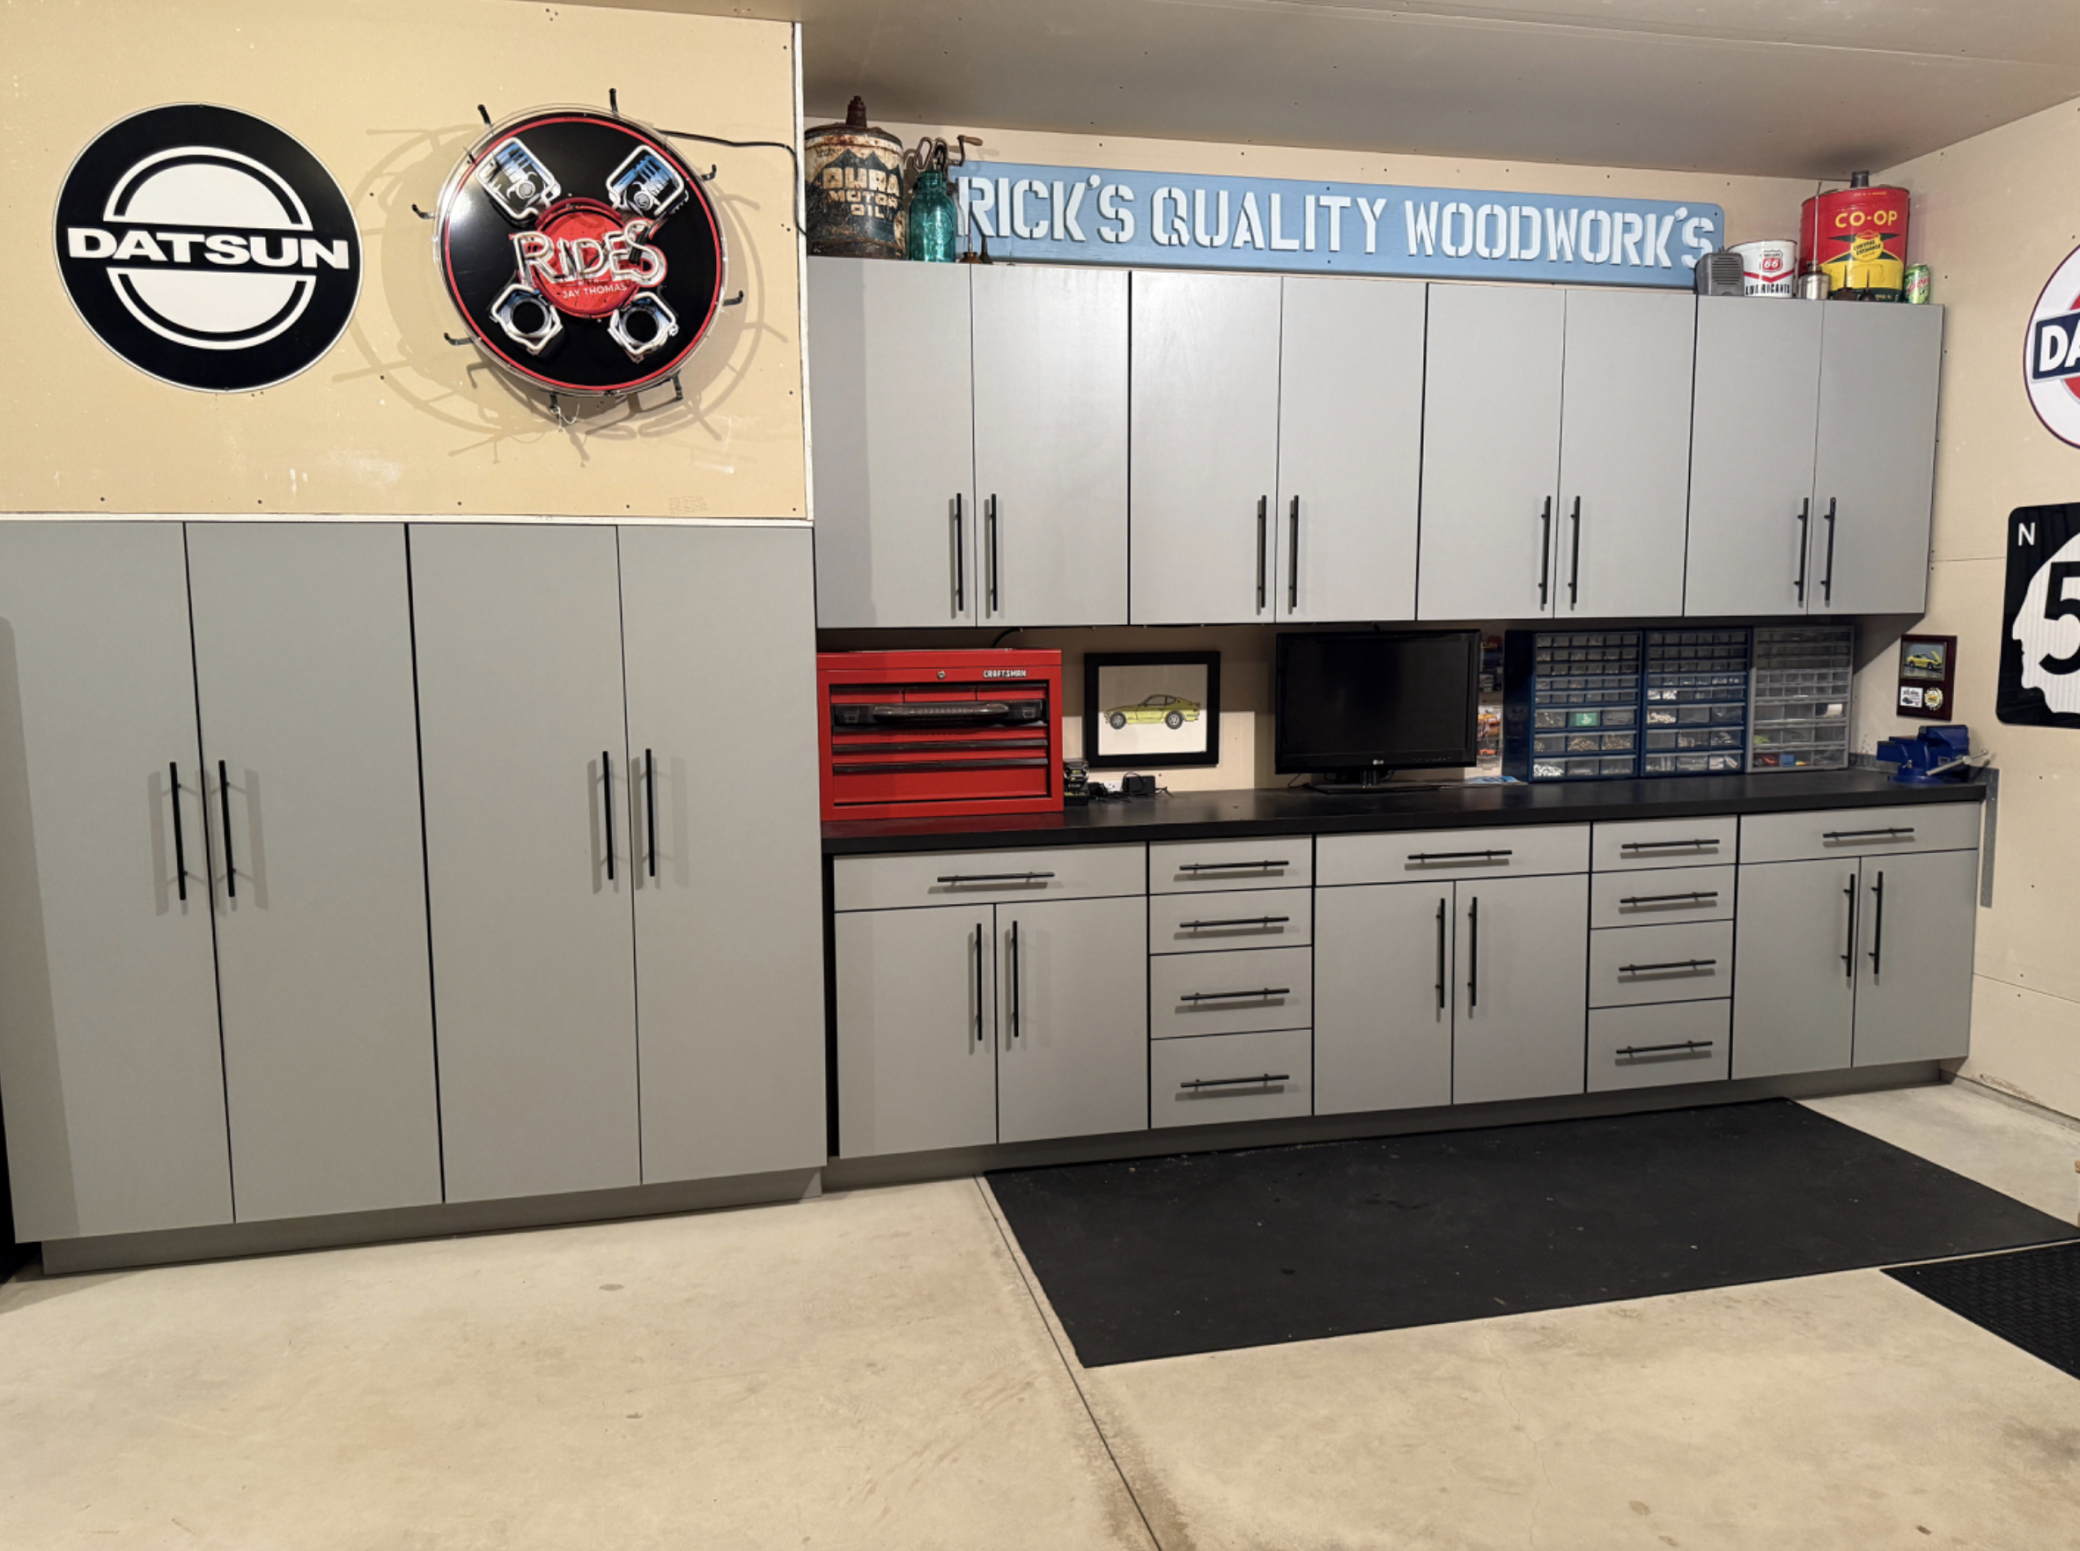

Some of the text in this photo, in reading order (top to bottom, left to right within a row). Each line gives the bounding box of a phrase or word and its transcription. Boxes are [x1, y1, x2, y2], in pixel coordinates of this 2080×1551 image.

[828, 190, 899, 208] MOTOR
[851, 204, 884, 219] OIL
[1835, 210, 1898, 228] CO-OP
[958, 174, 1715, 269] RICK'S QUALITY WOODWORK'S
[67, 227, 350, 270] DATSUN
[509, 218, 667, 288] RIDES
[562, 283, 628, 299] JAY THOMAS
[2018, 522, 2036, 546] N
[983, 669, 1027, 679] CRAFTSMAN
